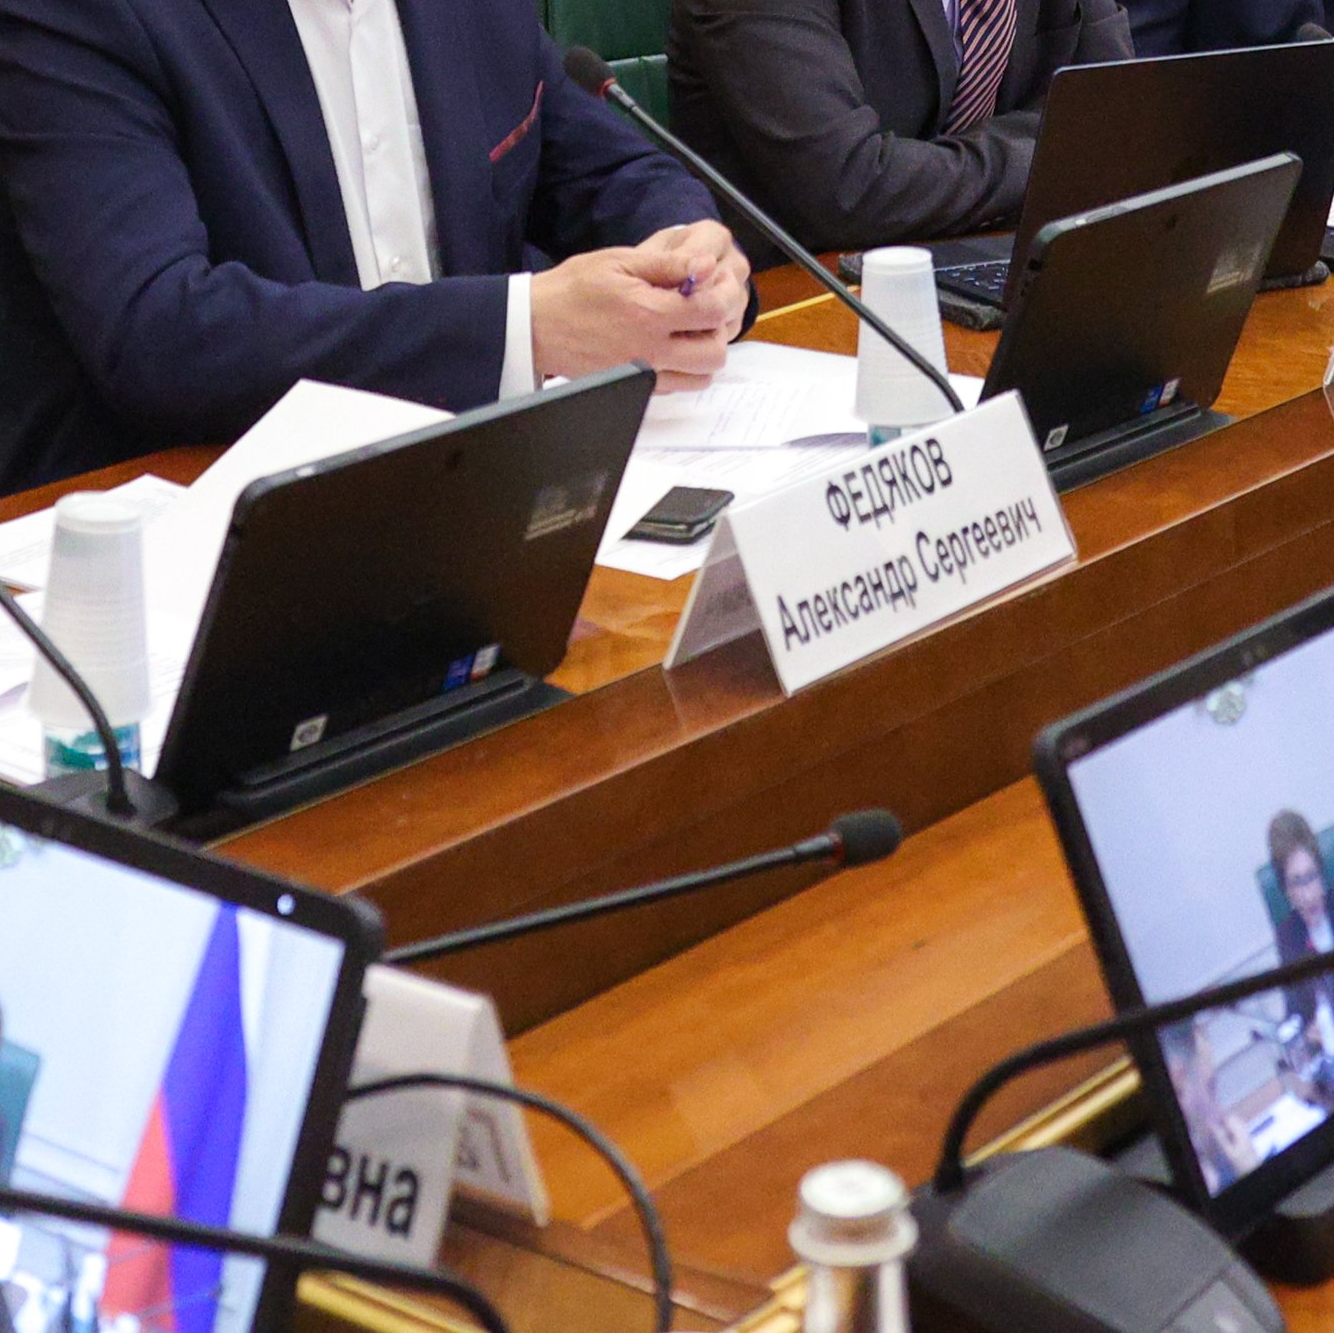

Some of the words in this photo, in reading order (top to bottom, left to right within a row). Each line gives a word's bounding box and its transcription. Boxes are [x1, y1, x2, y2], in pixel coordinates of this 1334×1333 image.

[825, 438, 954, 530] ФЕДЯКОВ
[776, 552, 919, 652] Александр
[916, 497, 1043, 583] Сергеевич
